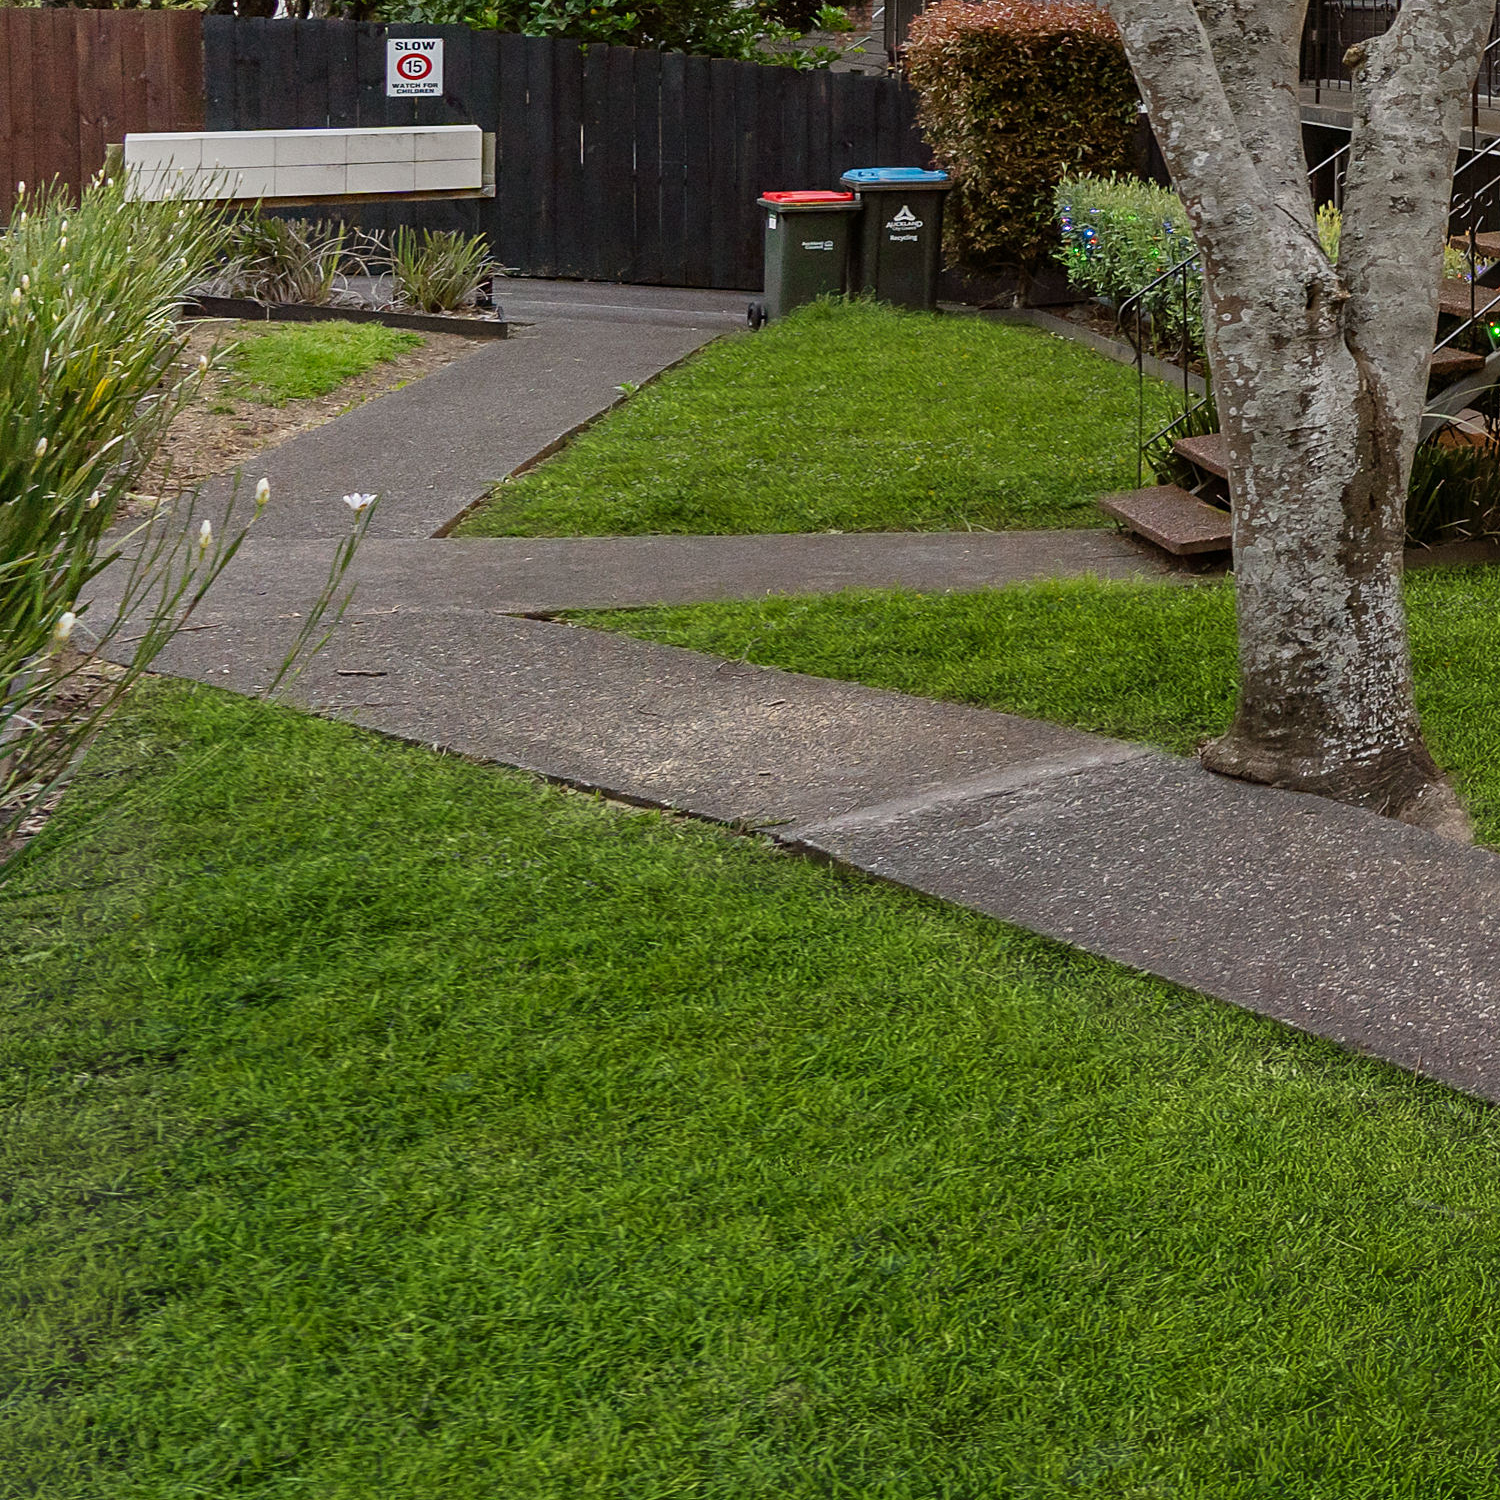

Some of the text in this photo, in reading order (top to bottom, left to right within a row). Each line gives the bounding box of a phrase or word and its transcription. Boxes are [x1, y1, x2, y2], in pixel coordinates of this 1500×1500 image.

[395, 41, 436, 51] SLOW
[406, 60, 422, 73] 15
[885, 220, 924, 228] AUCKLAND
